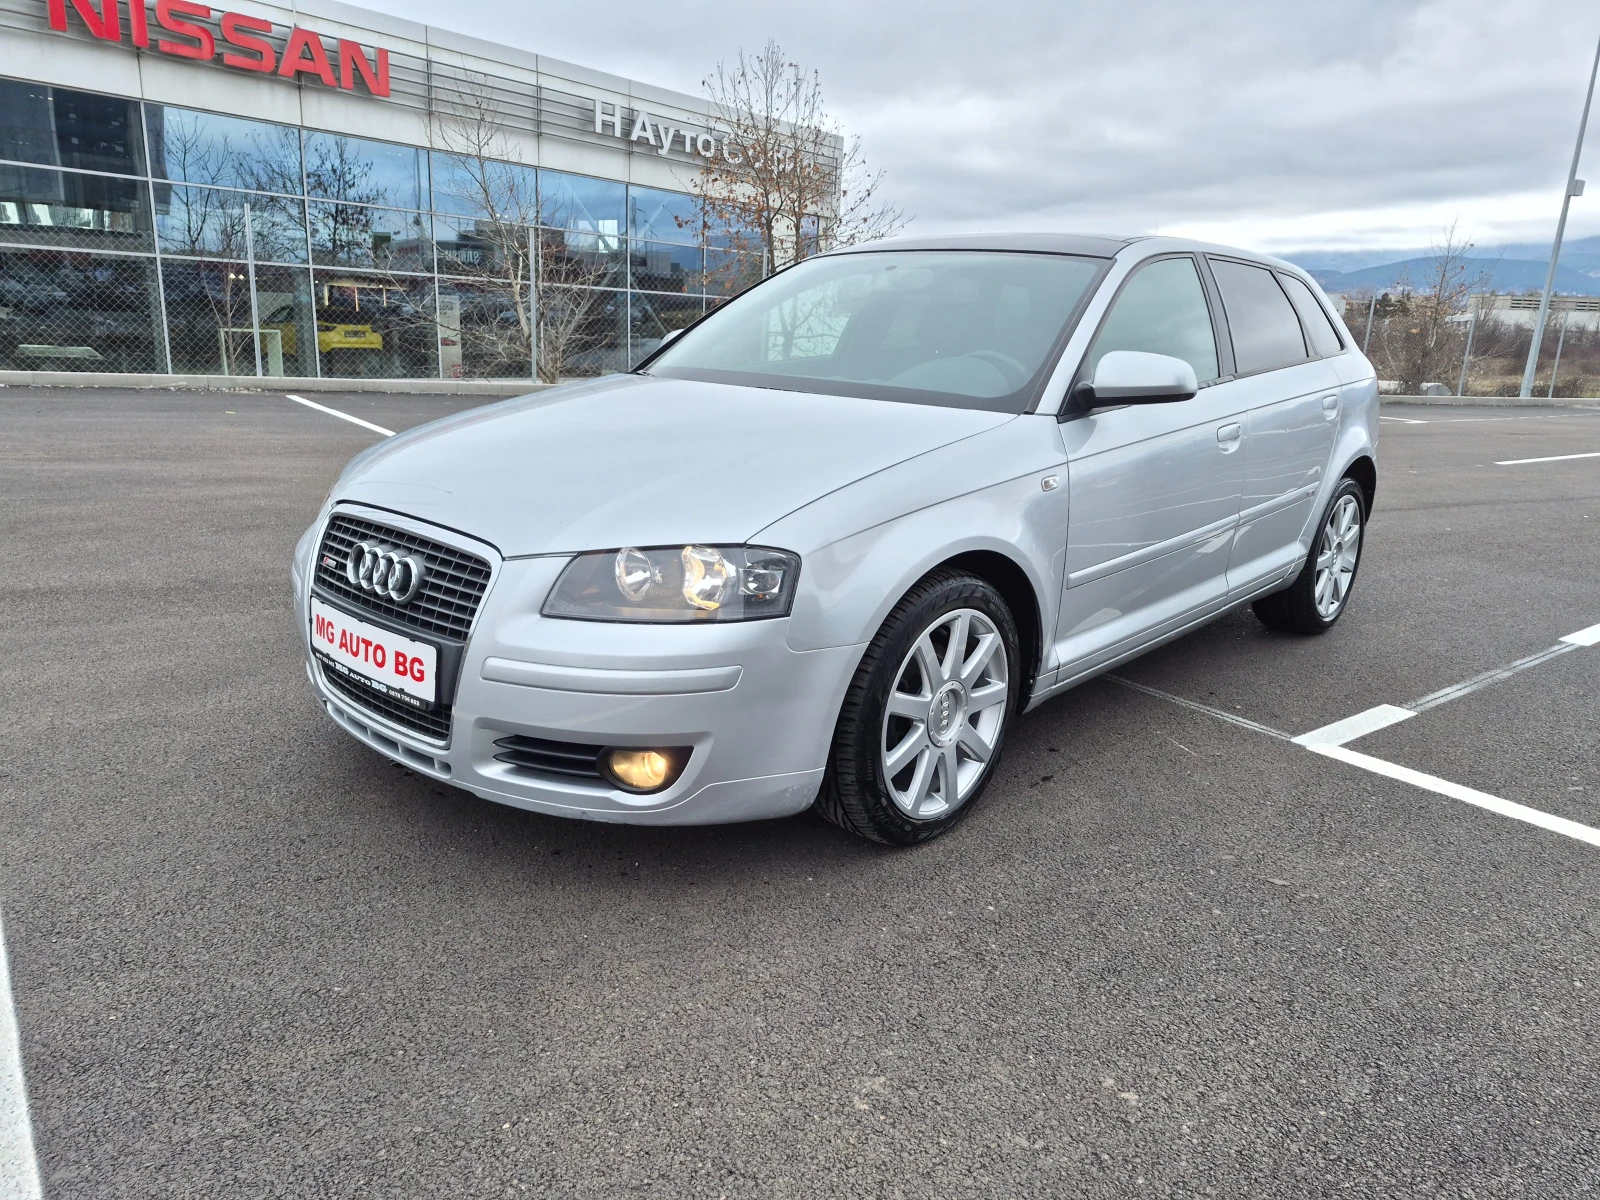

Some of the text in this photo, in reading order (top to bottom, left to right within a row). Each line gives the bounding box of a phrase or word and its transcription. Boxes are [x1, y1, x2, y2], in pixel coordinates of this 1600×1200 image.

[47, 0, 390, 97] NISSAN
[316, 613, 335, 644] MG
[338, 629, 387, 668] AUTO
[394, 650, 425, 682] BG
